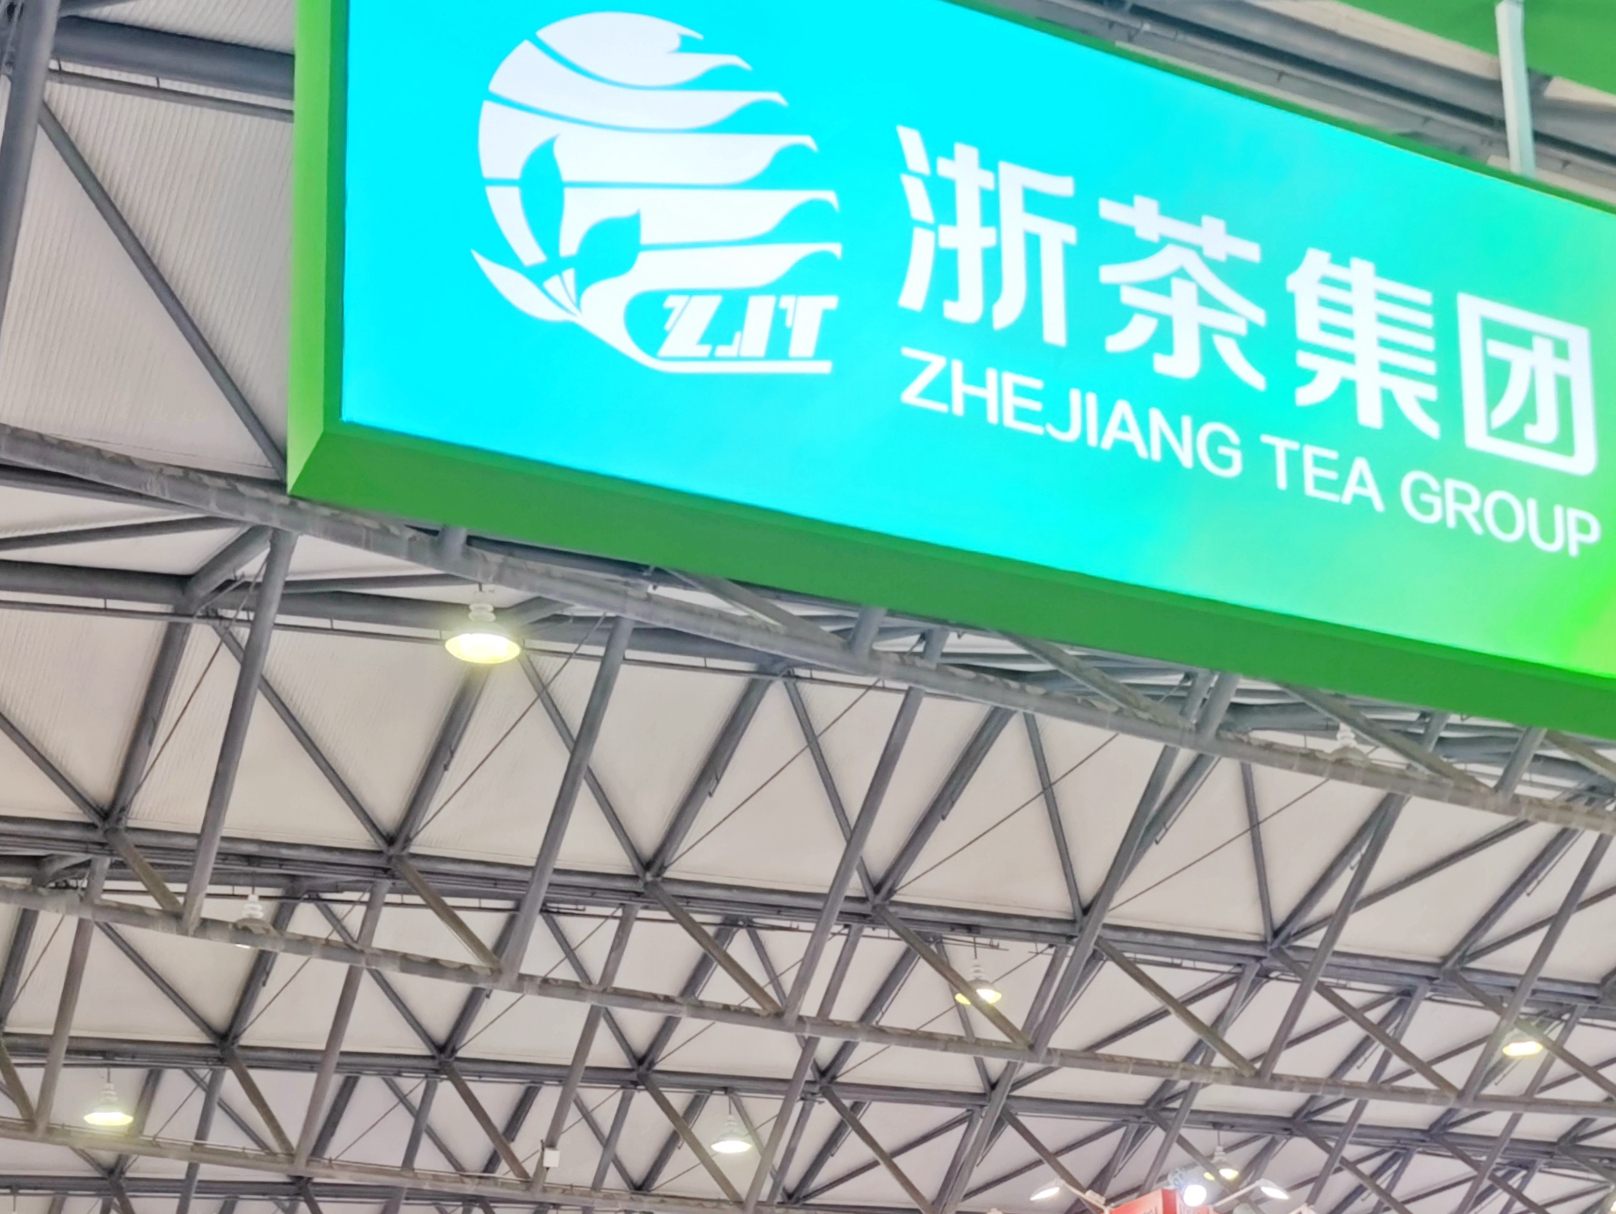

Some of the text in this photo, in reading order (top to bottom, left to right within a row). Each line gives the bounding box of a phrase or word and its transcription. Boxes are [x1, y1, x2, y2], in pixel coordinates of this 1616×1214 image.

[657, 294, 840, 359] ZJT
[896, 124, 1599, 478] 浙茶集团
[899, 346, 1602, 559] ZHEJIANG TEA GROUP
